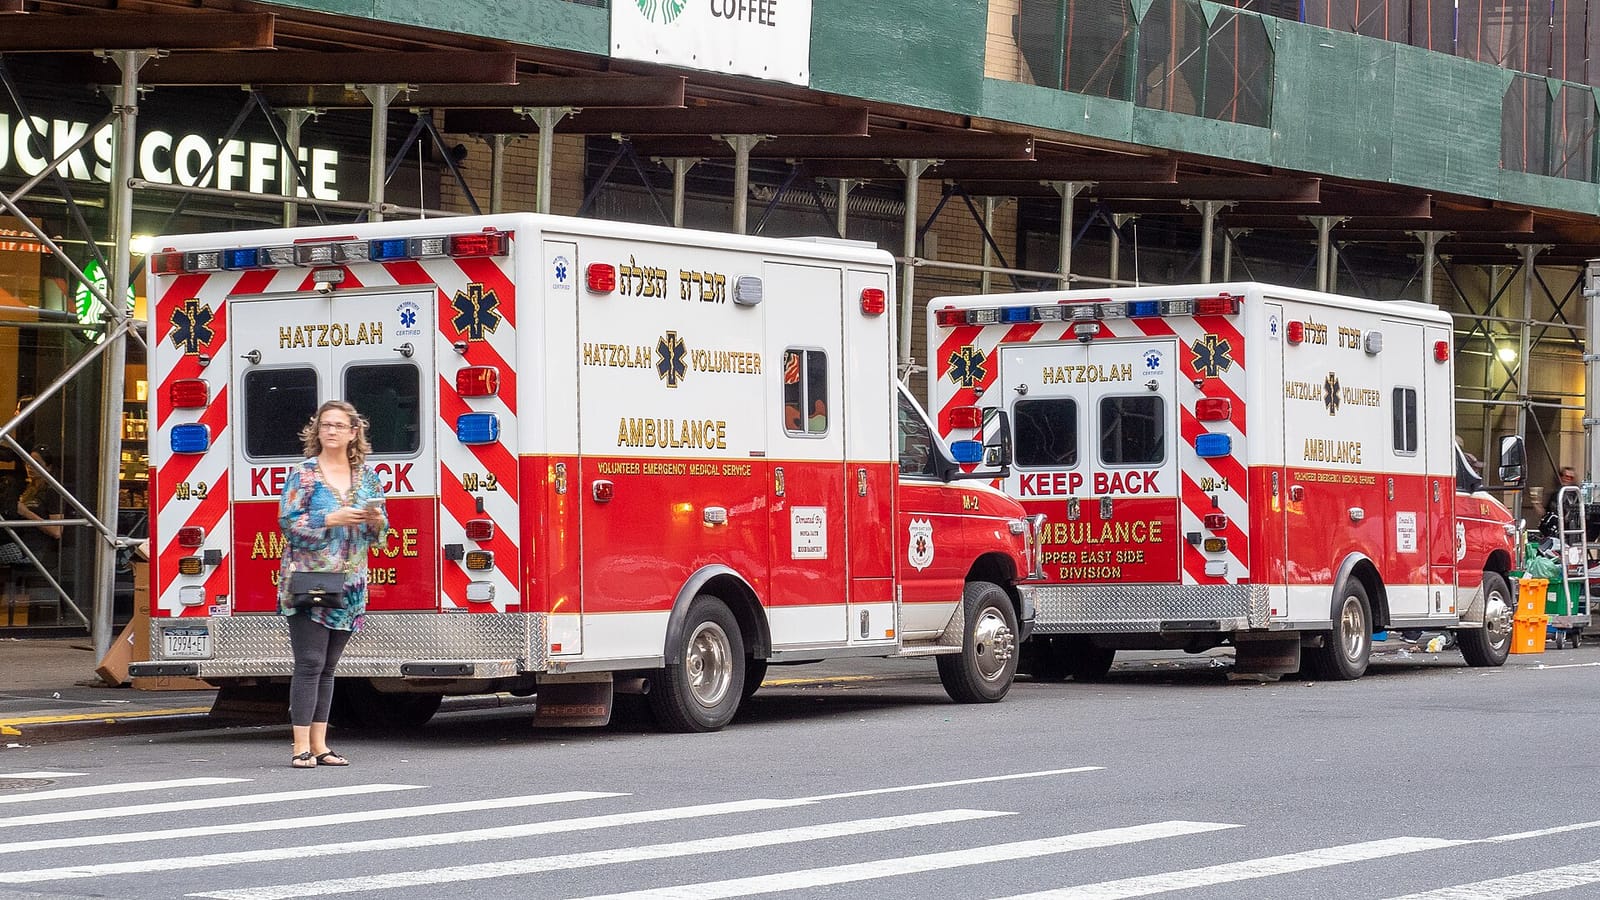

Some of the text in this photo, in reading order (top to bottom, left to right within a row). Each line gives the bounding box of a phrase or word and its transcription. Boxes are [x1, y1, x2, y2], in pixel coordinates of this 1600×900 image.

[710, 0, 777, 27] COFFEE
[139, 130, 338, 201] COFFEE
[619, 254, 726, 304] חברה הצלה
[279, 321, 383, 349] HATZOLAH
[583, 342, 762, 375] HATZOLAH VOLUNTEER
[1043, 363, 1133, 384] HATZOLAH
[1285, 380, 1380, 407] HATZOLAH VOLUNTEER
[617, 417, 727, 449] AMBULANCE
[1303, 437, 1362, 465] AMBULANCE
[463, 472, 497, 491] M-2
[598, 462, 752, 476] VOLUNTEER EMERGENCY MEDICAL SERVICE
[176, 481, 207, 500] M-2
[1020, 471, 1161, 496] KEEP BACK
[1080, 551, 1112, 564] EAST
[1116, 550, 1144, 563] SIDE
[1059, 566, 1121, 579] DIVISION
